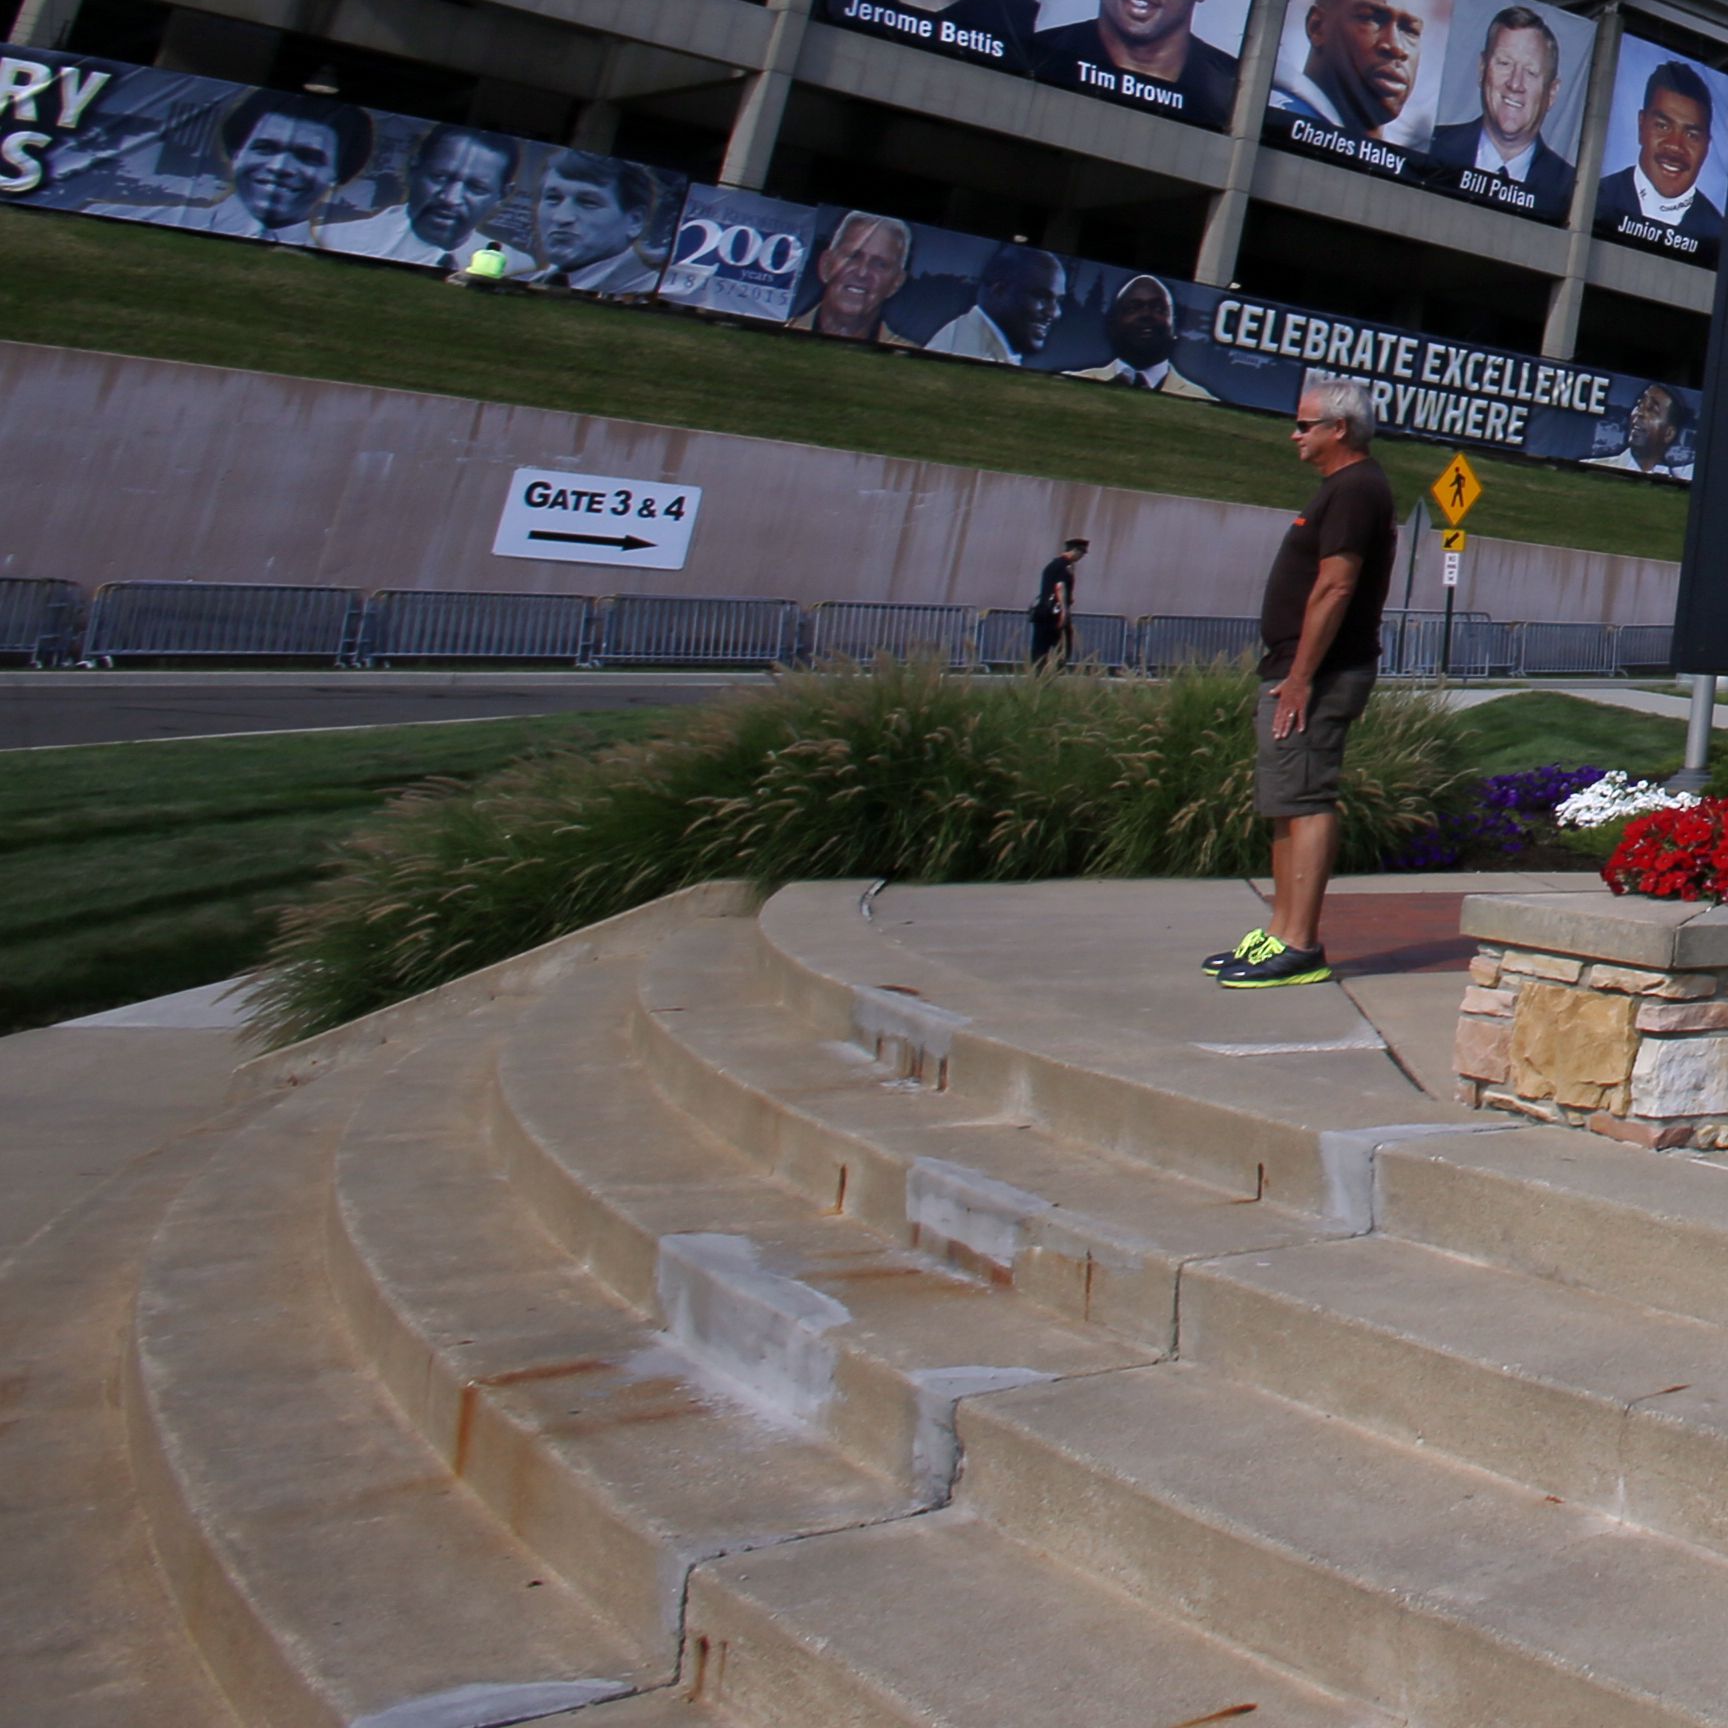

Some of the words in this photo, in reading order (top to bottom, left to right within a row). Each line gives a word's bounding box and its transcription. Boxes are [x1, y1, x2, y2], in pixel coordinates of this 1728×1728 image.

[940, 22, 1004, 57] Bettis
[0, 57, 112, 128] RY
[1077, 61, 1115, 90] Tim
[1121, 74, 1183, 110] Brown
[1291, 120, 1355, 156] Charles
[1359, 140, 1406, 174] Haley
[1459, 171, 1485, 194] Bill
[1488, 182, 1535, 208] Polian
[668, 219, 804, 274] 200
[1618, 216, 1662, 242] Junior
[1664, 229, 1699, 253] Seau
[740, 269, 774, 282] years
[1214, 300, 1419, 378] CELEBRATE
[1421, 342, 1610, 414] EXCELLENCE
[524, 480, 606, 513] GATE
[610, 490, 633, 516] 3
[637, 498, 656, 518] &
[664, 496, 686, 521] 4
